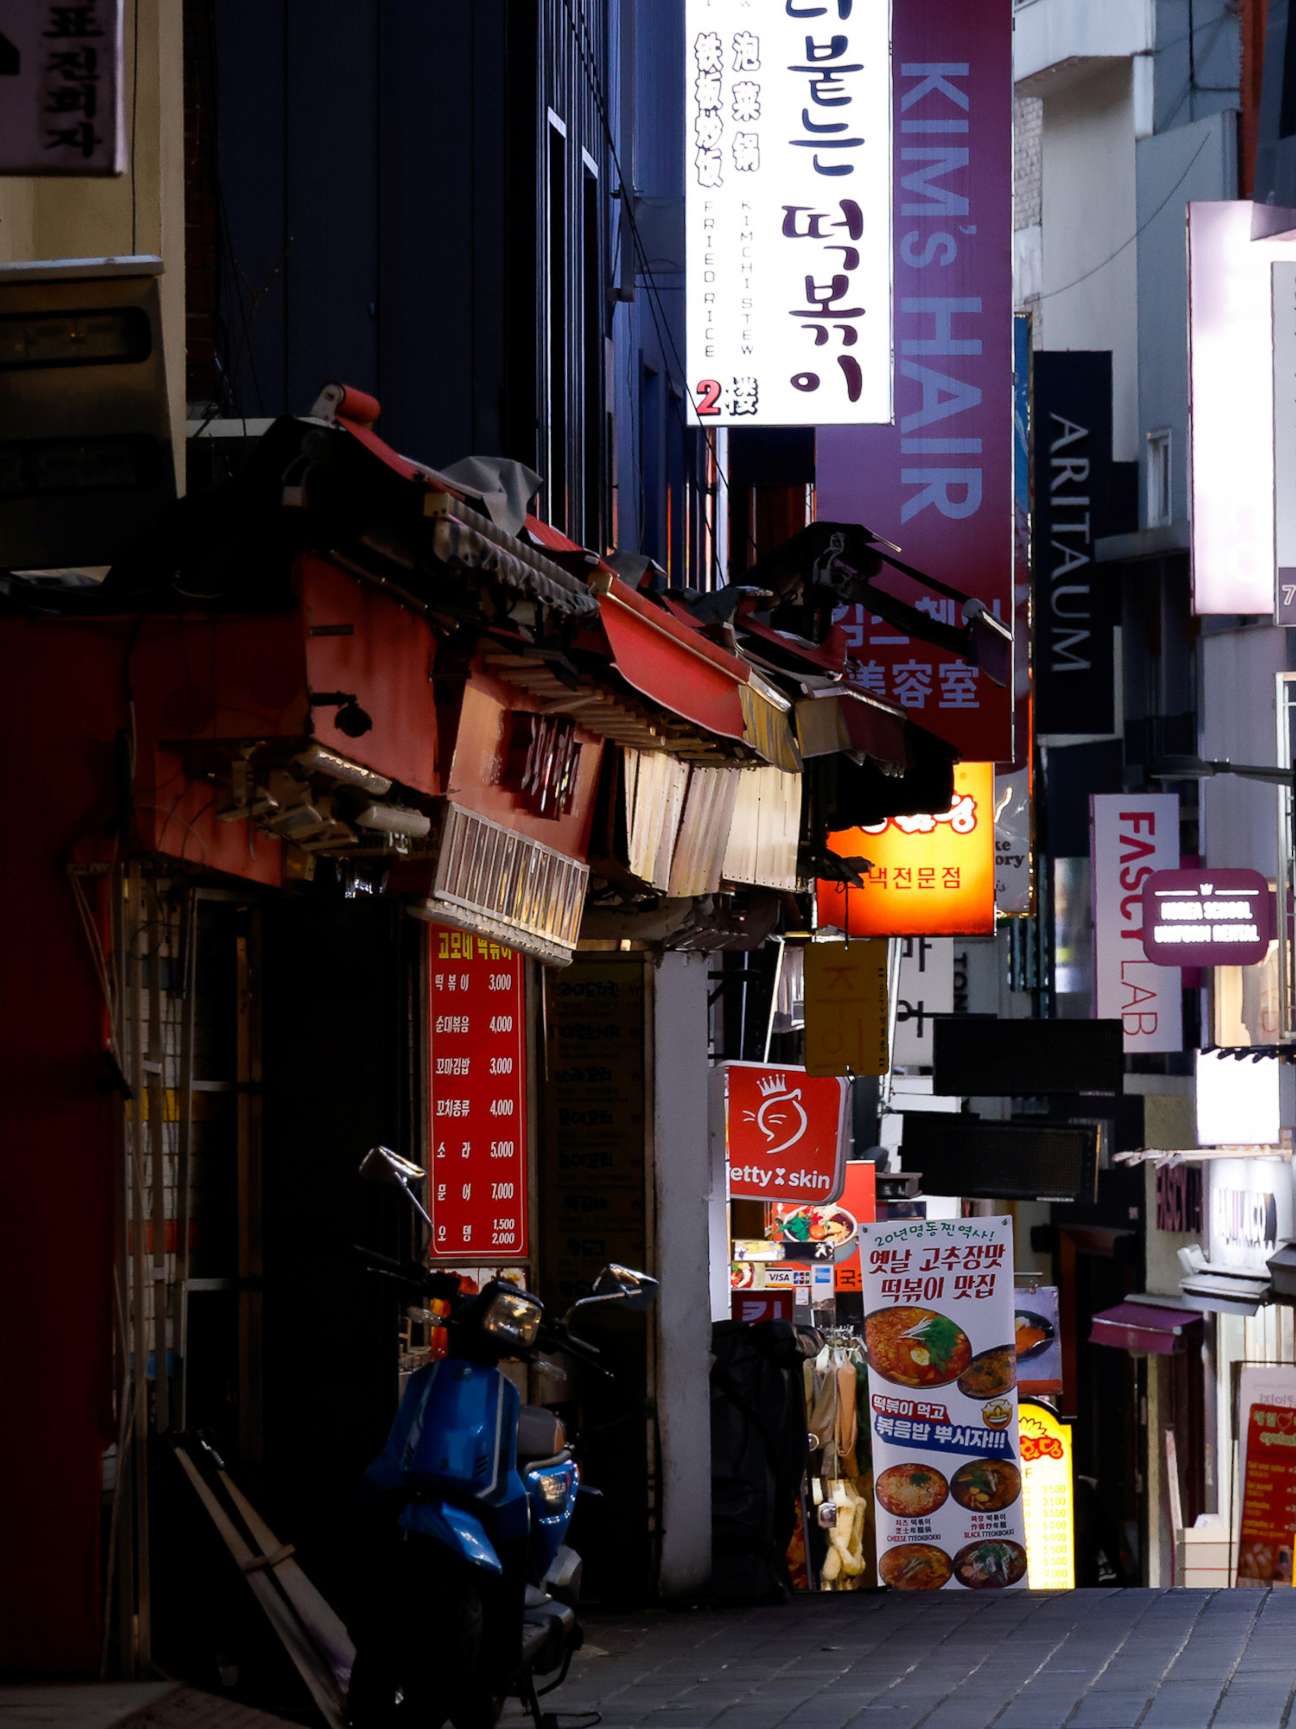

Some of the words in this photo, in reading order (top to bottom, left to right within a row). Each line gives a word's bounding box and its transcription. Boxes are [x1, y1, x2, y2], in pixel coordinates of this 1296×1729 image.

[703, 201, 715, 283] FRIED
[781, 199, 866, 402] 떡볶이
[703, 292, 715, 358] RICE
[741, 298, 753, 356] STEW
[900, 296, 983, 526] HAIR
[1048, 410, 1091, 672] ARITAUM
[838, 866, 961, 890] 낵전문점
[435, 973, 470, 991] 떡볶이
[488, 973, 511, 991] 3,000
[1120, 959, 1158, 1036] LAB
[435, 1016, 470, 1033] 순대볶음
[489, 1016, 512, 1033] 4,000
[435, 1058, 470, 1076] 꼬마김밥
[489, 1057, 512, 1075] 3,000
[436, 1099, 470, 1117] 꼬치종류
[489, 1099, 513, 1117] 4,000
[490, 1141, 514, 1158] 5,000
[789, 1169, 831, 1190] skin
[491, 1183, 514, 1200] 7,000
[492, 1218, 515, 1231] 1,500
[491, 1232, 515, 1245] 2,000
[869, 1248, 912, 1274] 옛날
[919, 1243, 1007, 1272] 고추장맛
[769, 1273, 790, 1281] VISA
[881, 1276, 945, 1304] 떡볶이
[953, 1273, 997, 1300] 맛집
[873, 1394, 914, 1416] 떡볶이
[917, 1403, 945, 1420] 먹고
[877, 1415, 931, 1442] 볶음밥
[887, 1535, 907, 1543] CHEESE
[964, 1531, 981, 1539] BLACK
